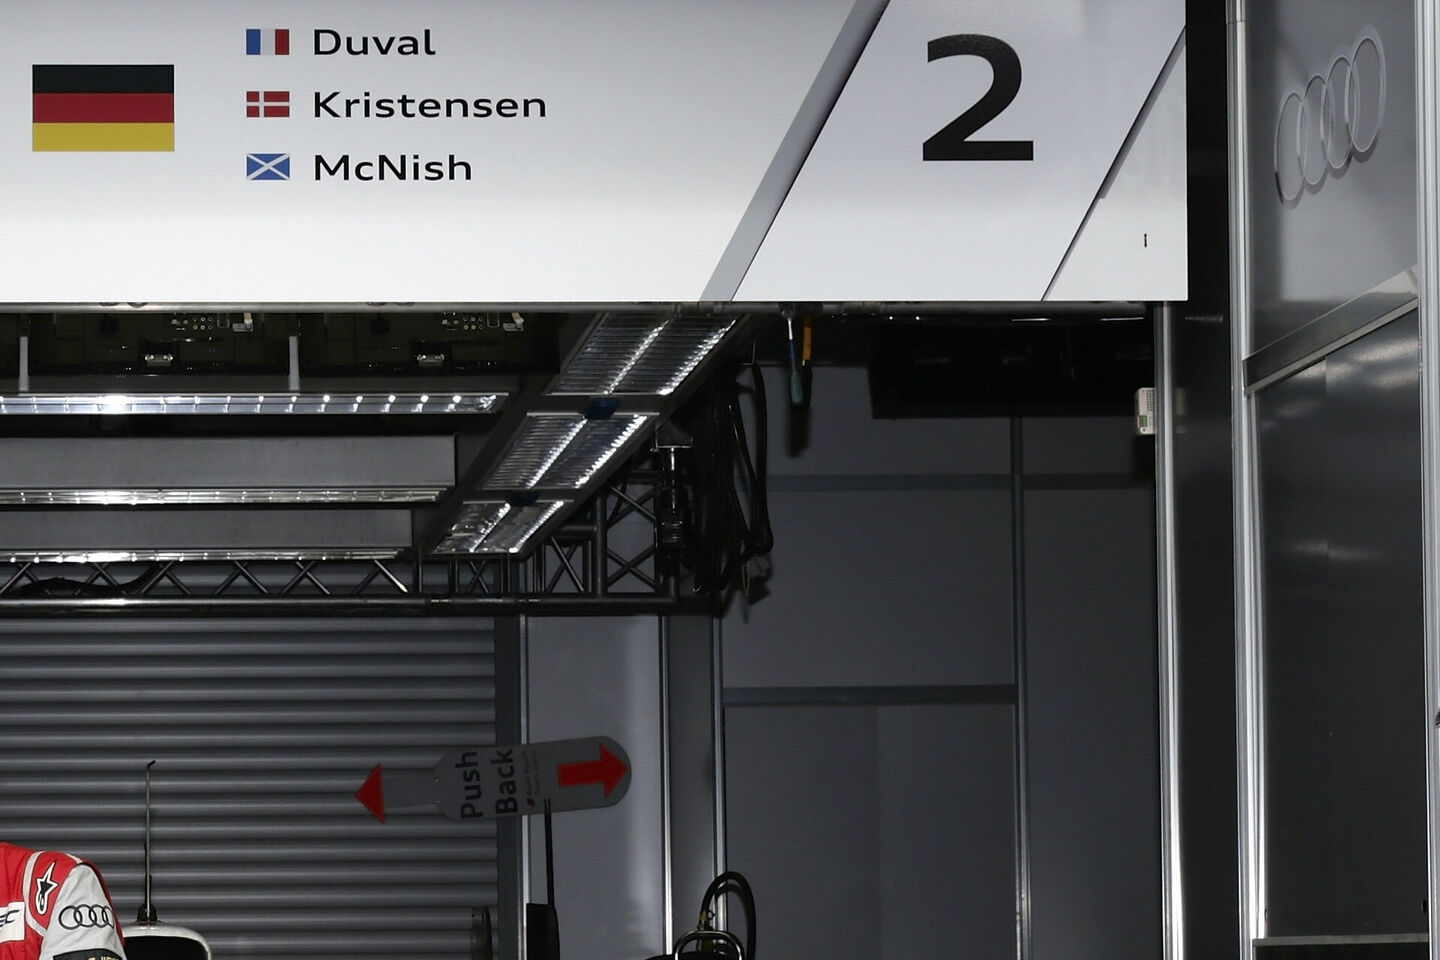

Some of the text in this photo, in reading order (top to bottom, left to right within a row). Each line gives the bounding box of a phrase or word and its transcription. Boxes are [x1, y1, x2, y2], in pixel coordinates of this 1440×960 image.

[314, 28, 436, 56] Duval
[314, 91, 546, 118] Kristensen
[922, 33, 1034, 161] 2
[314, 154, 472, 181] McNish
[455, 750, 483, 820] Push
[490, 748, 518, 815] Back
